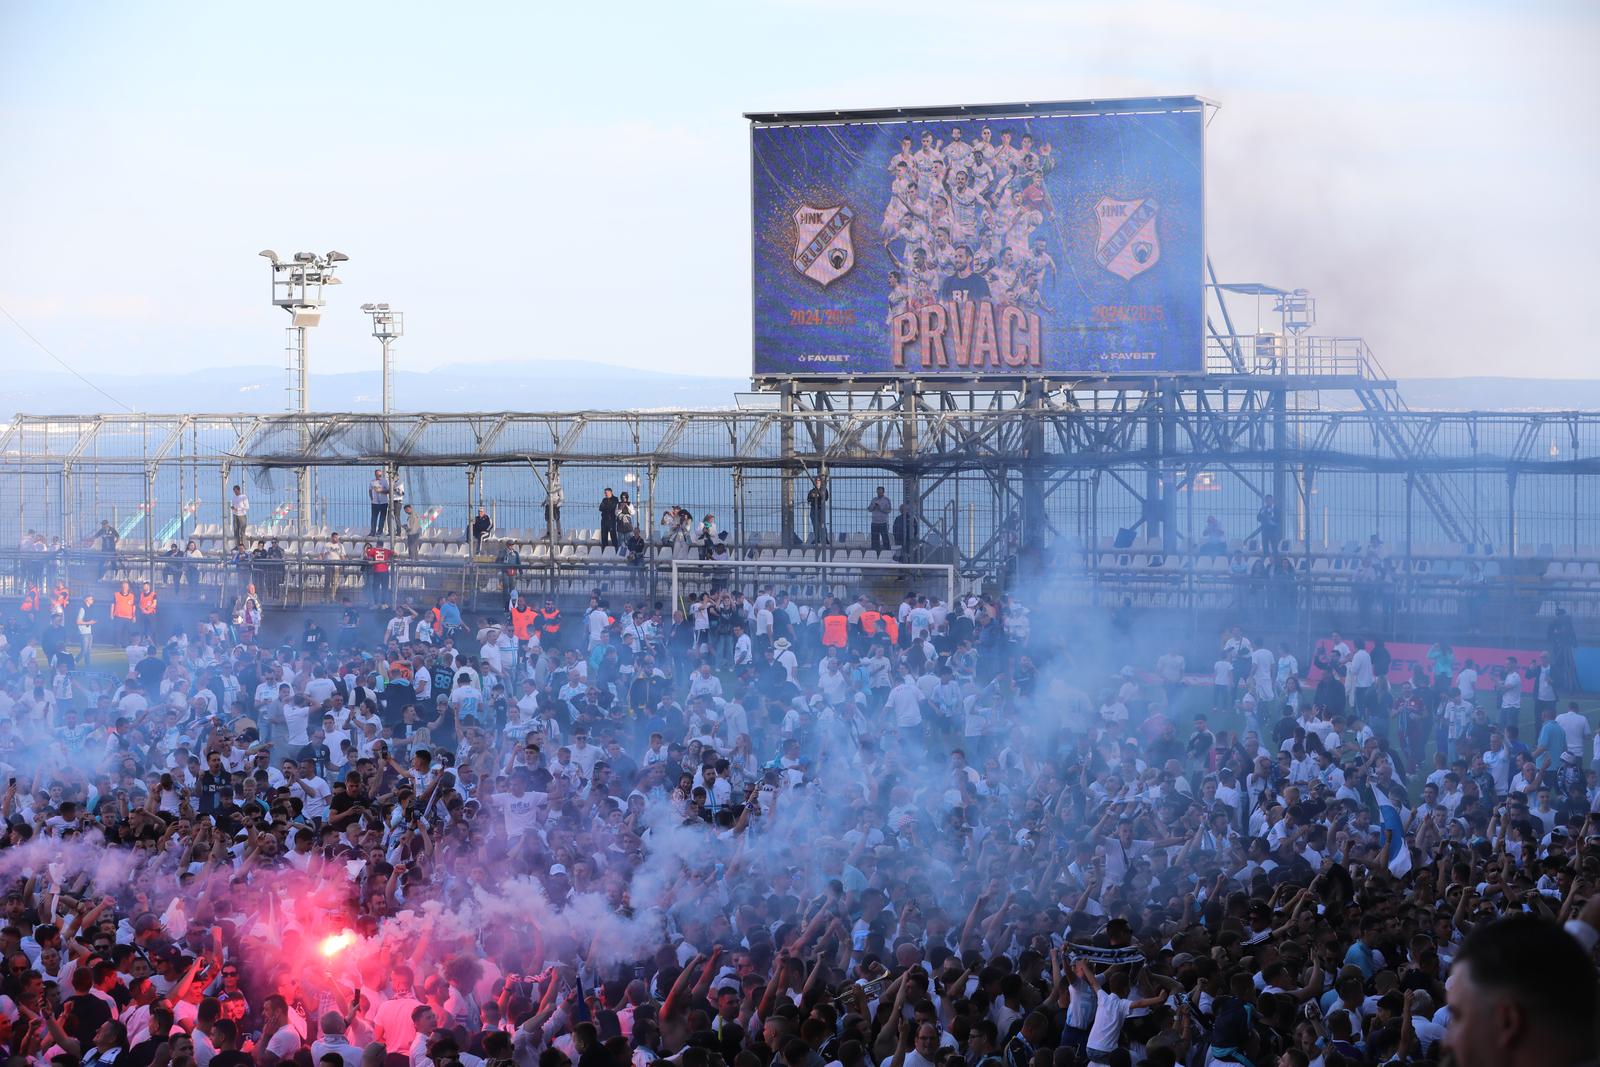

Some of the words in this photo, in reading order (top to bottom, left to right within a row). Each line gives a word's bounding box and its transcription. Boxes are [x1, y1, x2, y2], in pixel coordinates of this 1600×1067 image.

[800, 212, 824, 225] HNK
[801, 212, 850, 268] RIJEKA
[893, 300, 1041, 367] PRVACI
[807, 354, 850, 362] FAVBET
[1110, 352, 1157, 360] FAVBET
